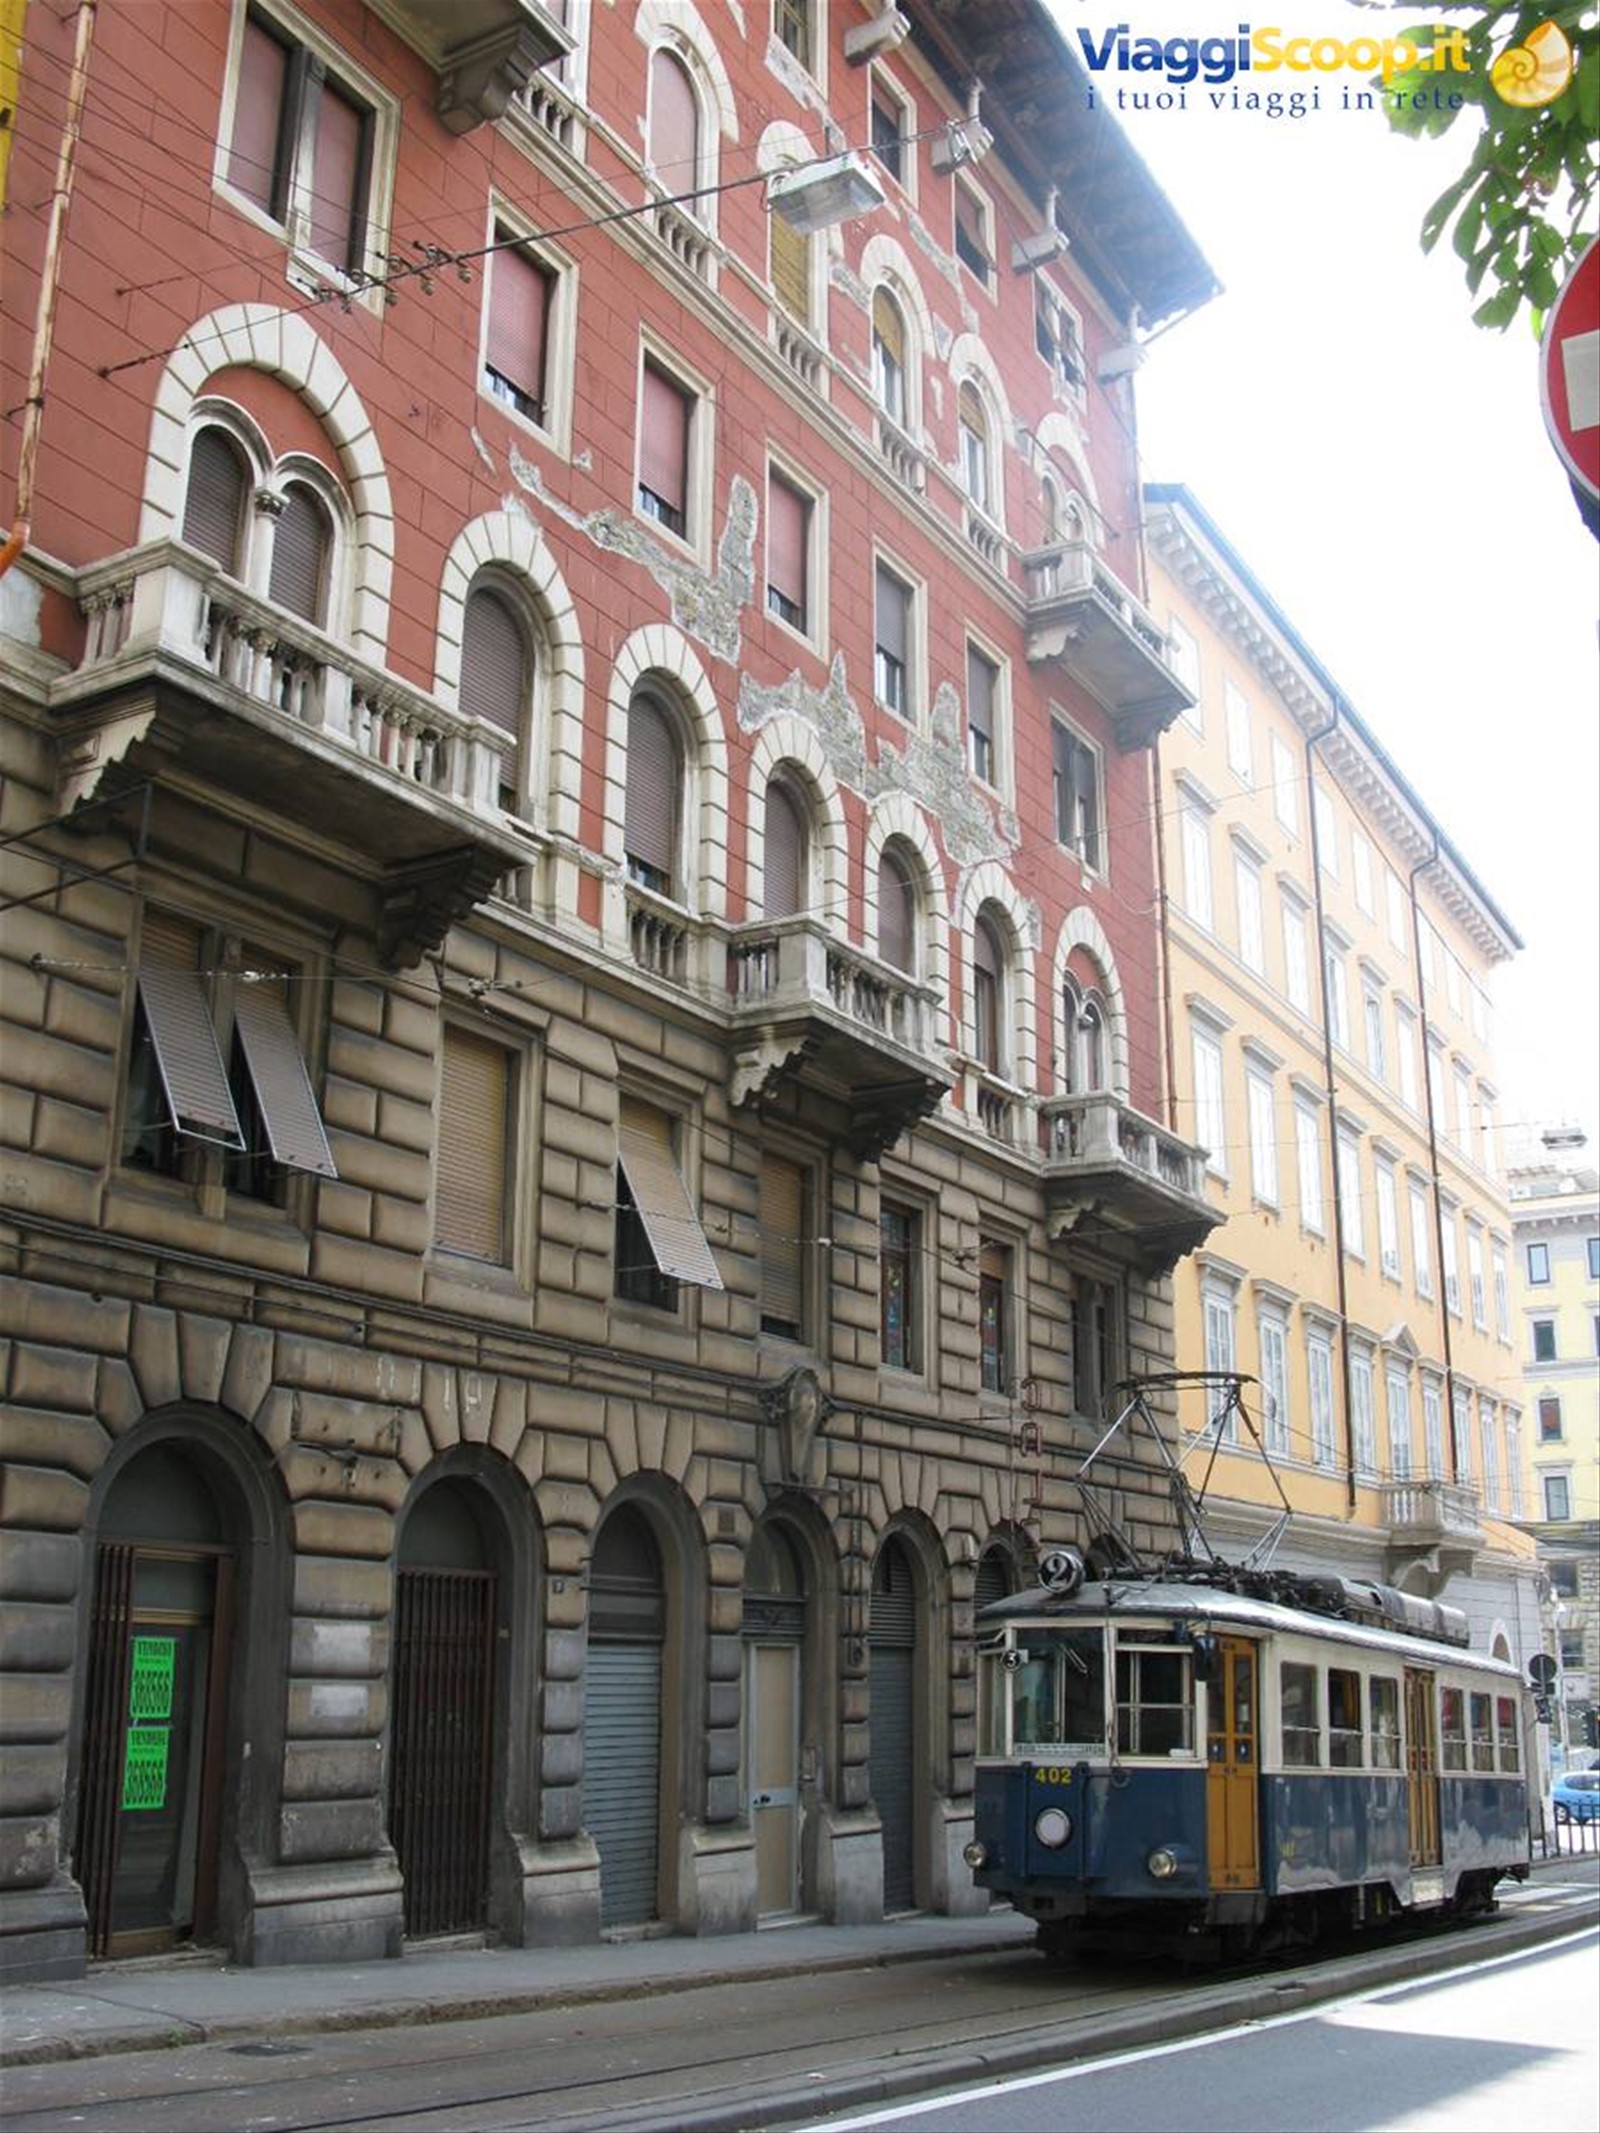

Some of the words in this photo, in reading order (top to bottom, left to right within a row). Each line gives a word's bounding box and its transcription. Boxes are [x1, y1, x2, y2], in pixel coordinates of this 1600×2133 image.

[1046, 1556, 1068, 1588] 2
[1006, 1651, 1016, 1668] 3
[1035, 1767, 1072, 1785] 402
